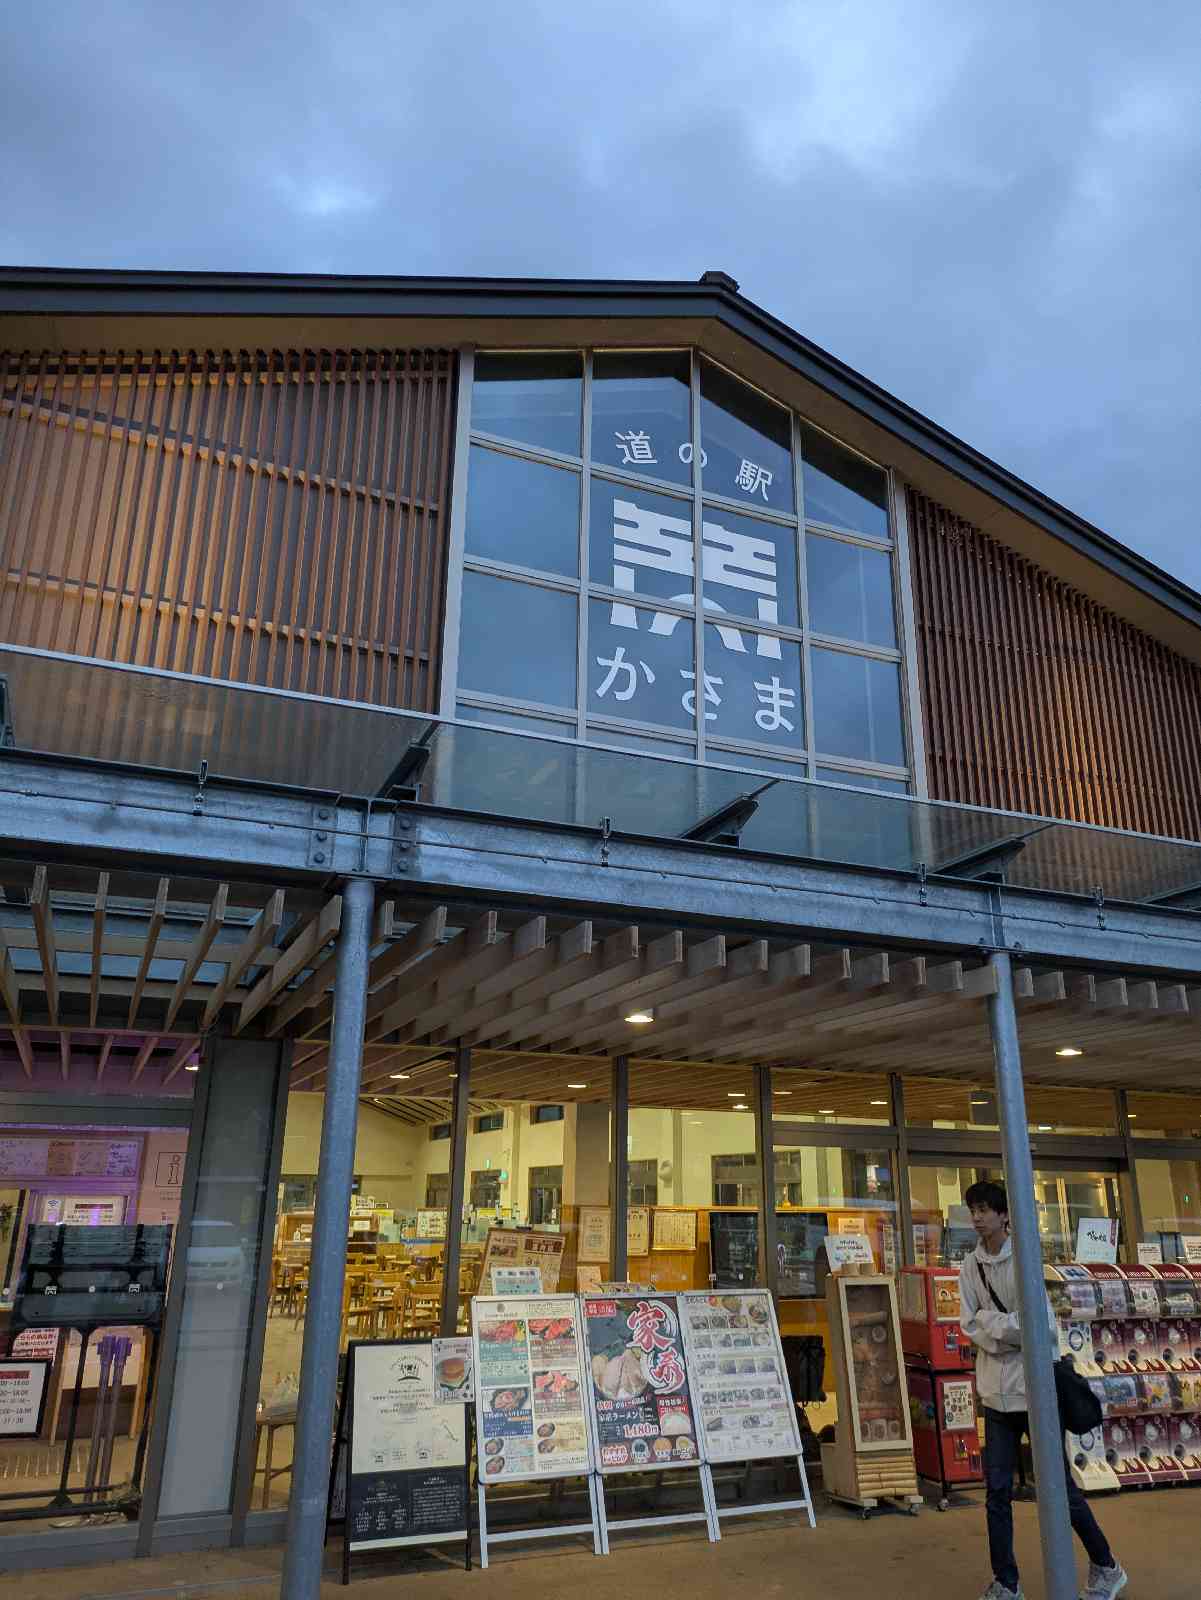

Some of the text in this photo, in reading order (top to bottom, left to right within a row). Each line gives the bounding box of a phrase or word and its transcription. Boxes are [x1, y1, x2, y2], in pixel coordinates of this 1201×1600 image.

[614, 429, 773, 501] 道の駅
[596, 646, 796, 733] かさま
